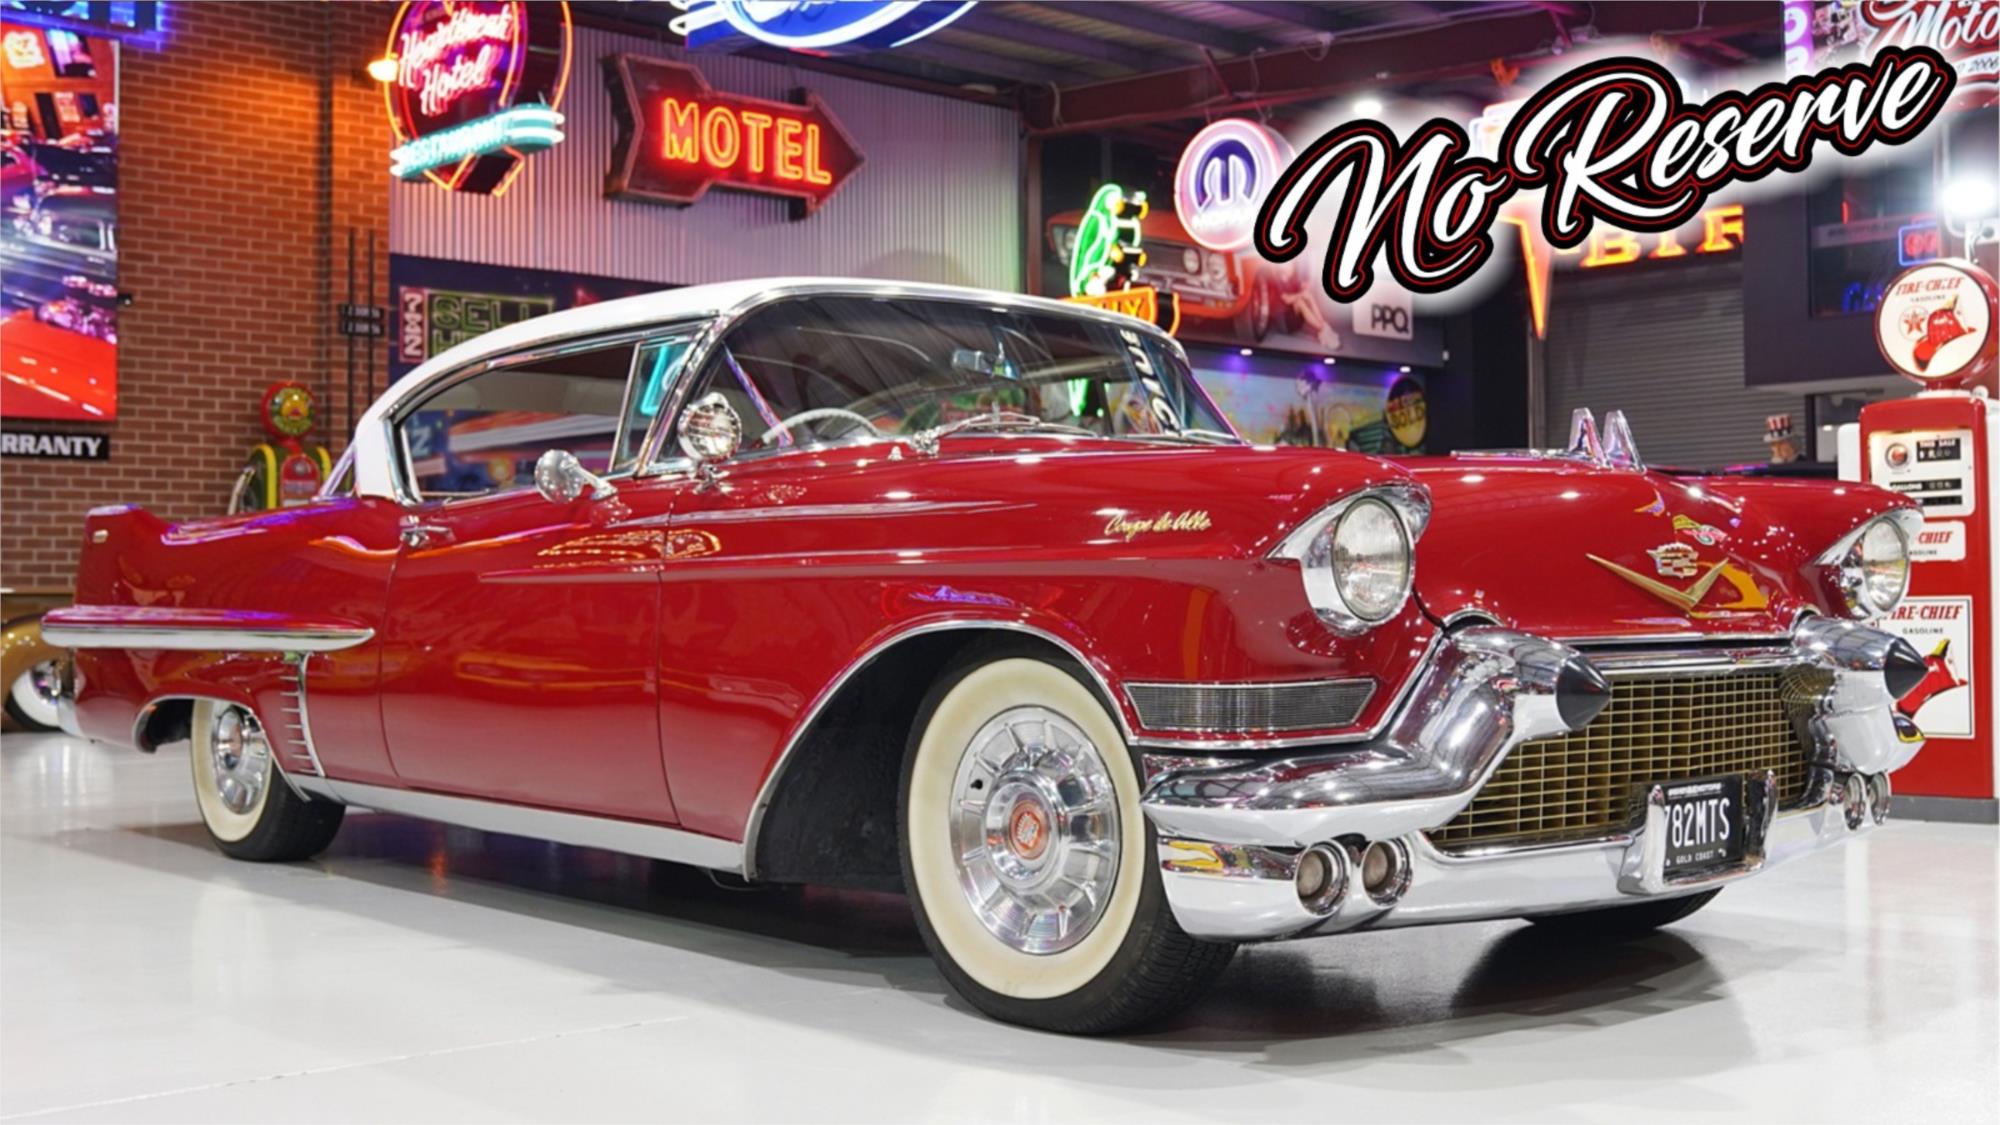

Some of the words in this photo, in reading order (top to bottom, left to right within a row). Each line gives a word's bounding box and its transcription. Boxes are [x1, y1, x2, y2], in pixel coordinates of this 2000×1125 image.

[420, 44, 494, 115] Hotel
[663, 97, 833, 186] MOTEL
[1371, 303, 1410, 334] PPQ
[0, 433, 102, 457] RRANTY
[1891, 604, 1963, 620] IRE-CHIEF
[1902, 627, 1944, 635] GASOLINE
[1665, 797, 1731, 848] 782MTS
